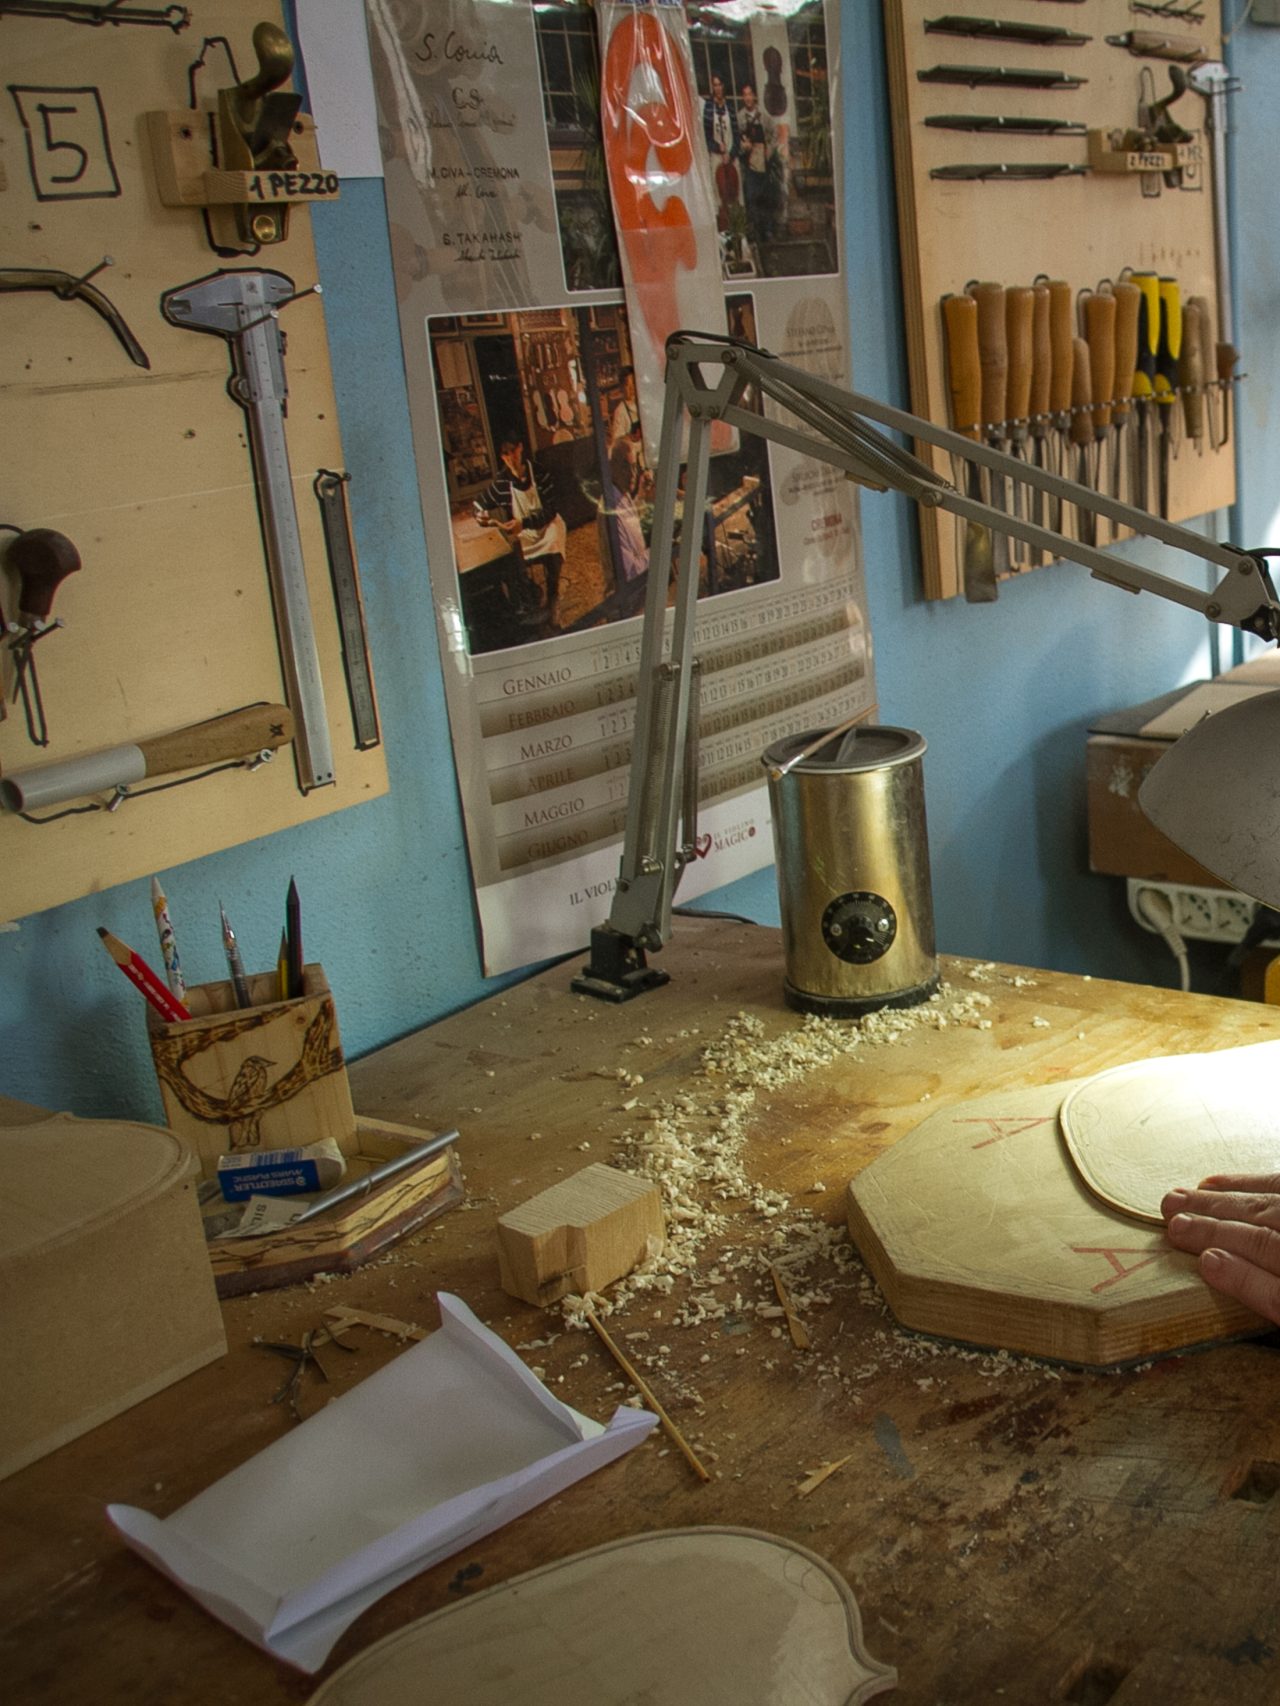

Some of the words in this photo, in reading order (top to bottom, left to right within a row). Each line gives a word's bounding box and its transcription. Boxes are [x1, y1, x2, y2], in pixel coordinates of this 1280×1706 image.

[37, 104, 88, 183] 5
[249, 176, 265, 200] 1
[271, 172, 339, 196] PEZZO
[473, 167, 520, 179] CREMONA
[502, 667, 572, 696] GENNAIO
[603, 654, 609, 669] 2
[625, 649, 630, 662] 4
[702, 627, 710, 640] 12
[508, 700, 576, 730] FEBBRAIO
[520, 734, 573, 760] MARZO
[600, 723, 605, 736] 1
[611, 719, 616, 733] 2
[527, 767, 576, 793] APRILE
[523, 797, 585, 828] MAGGIO
[528, 830, 589, 858] GIUGNO
[569, 891, 584, 906] IL
[585, 877, 618, 900] VIOL
[951, 1116, 1058, 1151] A
[232, 1173, 270, 1183] PLASTIC
[234, 1177, 296, 1192] STAEDTLER
[270, 1169, 304, 1179] MARS
[1072, 1246, 1175, 1294] A
